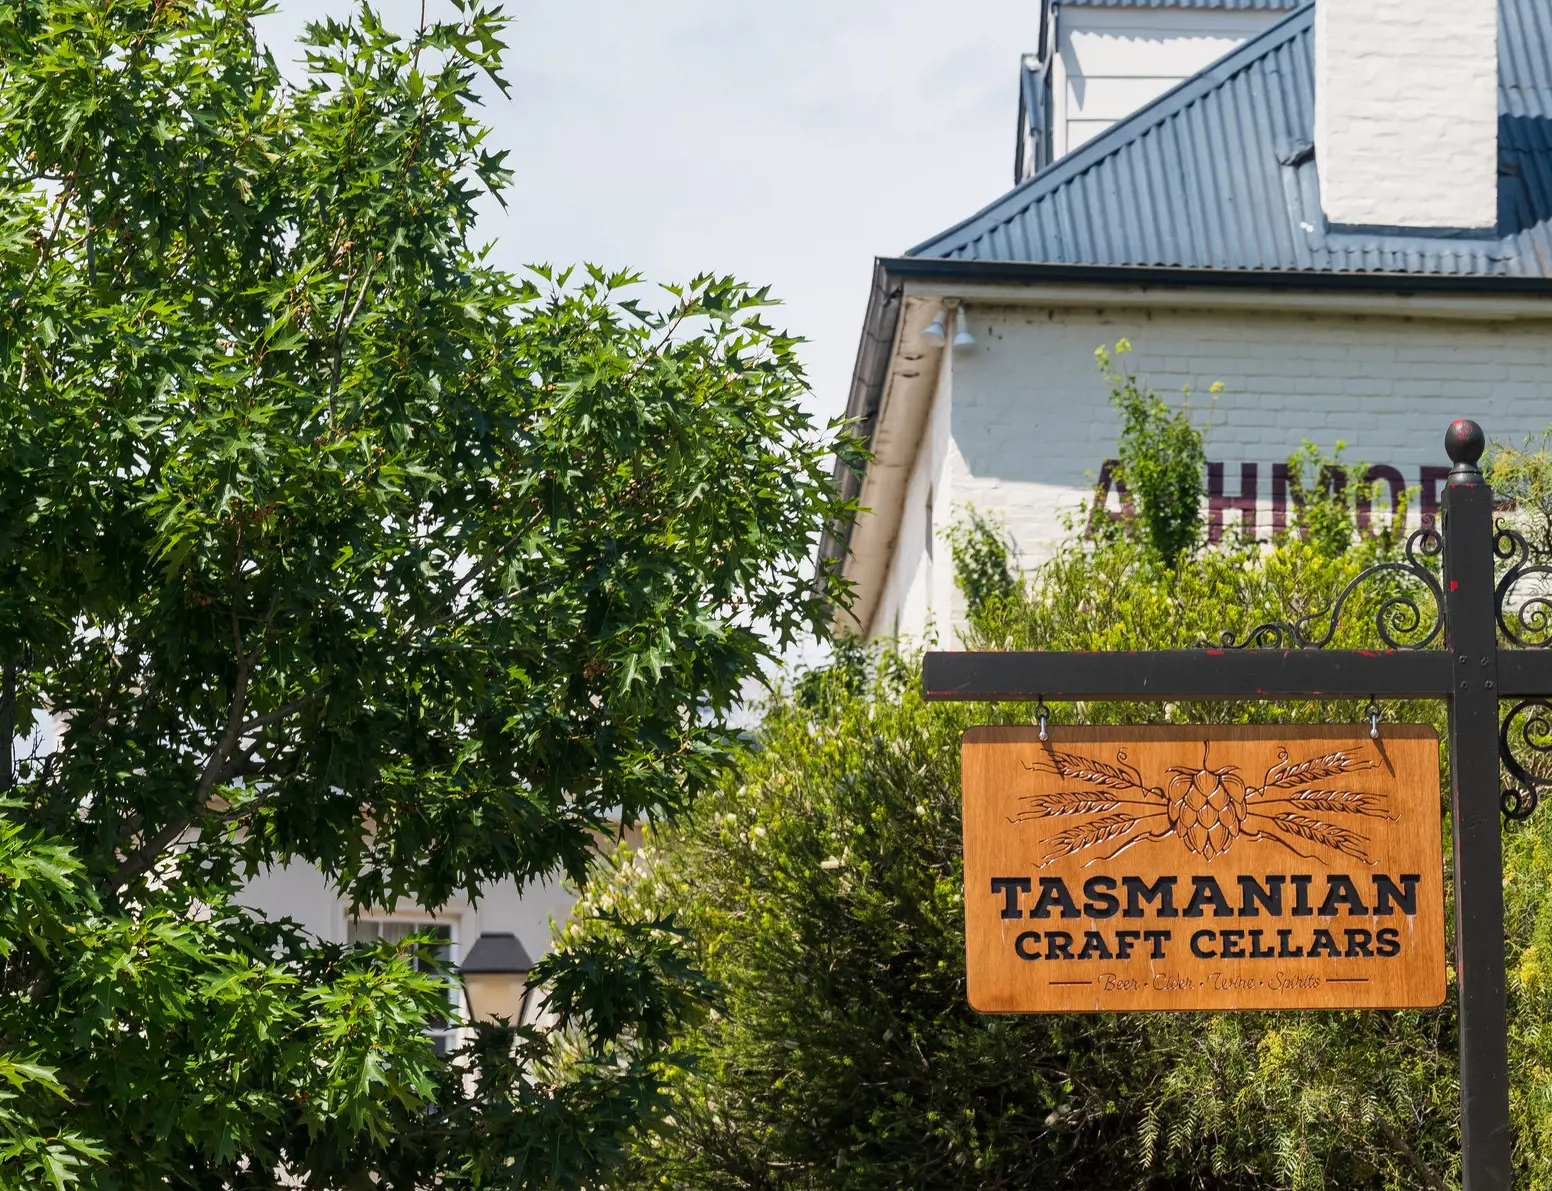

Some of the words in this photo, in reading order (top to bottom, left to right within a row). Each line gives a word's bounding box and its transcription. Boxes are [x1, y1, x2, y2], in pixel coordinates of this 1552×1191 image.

[990, 873, 1421, 919] TASMANIAN
[1014, 930, 1171, 960] CRAFT
[1189, 929, 1400, 959] CELLARS
[1098, 972, 1140, 991] Beer
[1152, 972, 1195, 991] Cider
[1207, 972, 1255, 990] Wine
[1267, 971, 1320, 993] Spirits
